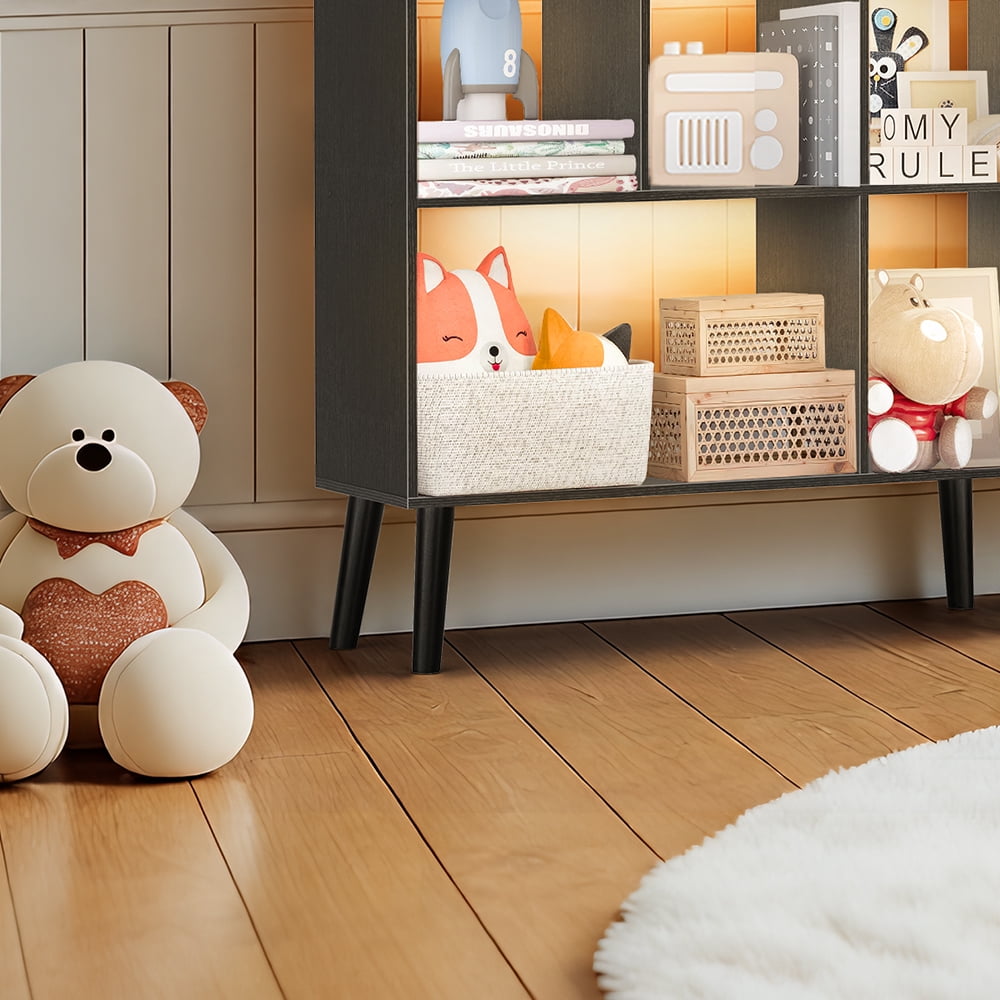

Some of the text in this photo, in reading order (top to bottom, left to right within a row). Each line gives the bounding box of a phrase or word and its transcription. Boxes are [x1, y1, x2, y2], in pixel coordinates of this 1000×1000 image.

[503, 49, 517, 78] 8
[464, 123, 590, 138] DINOSAURS
[450, 159, 605, 173] The Little Prince
